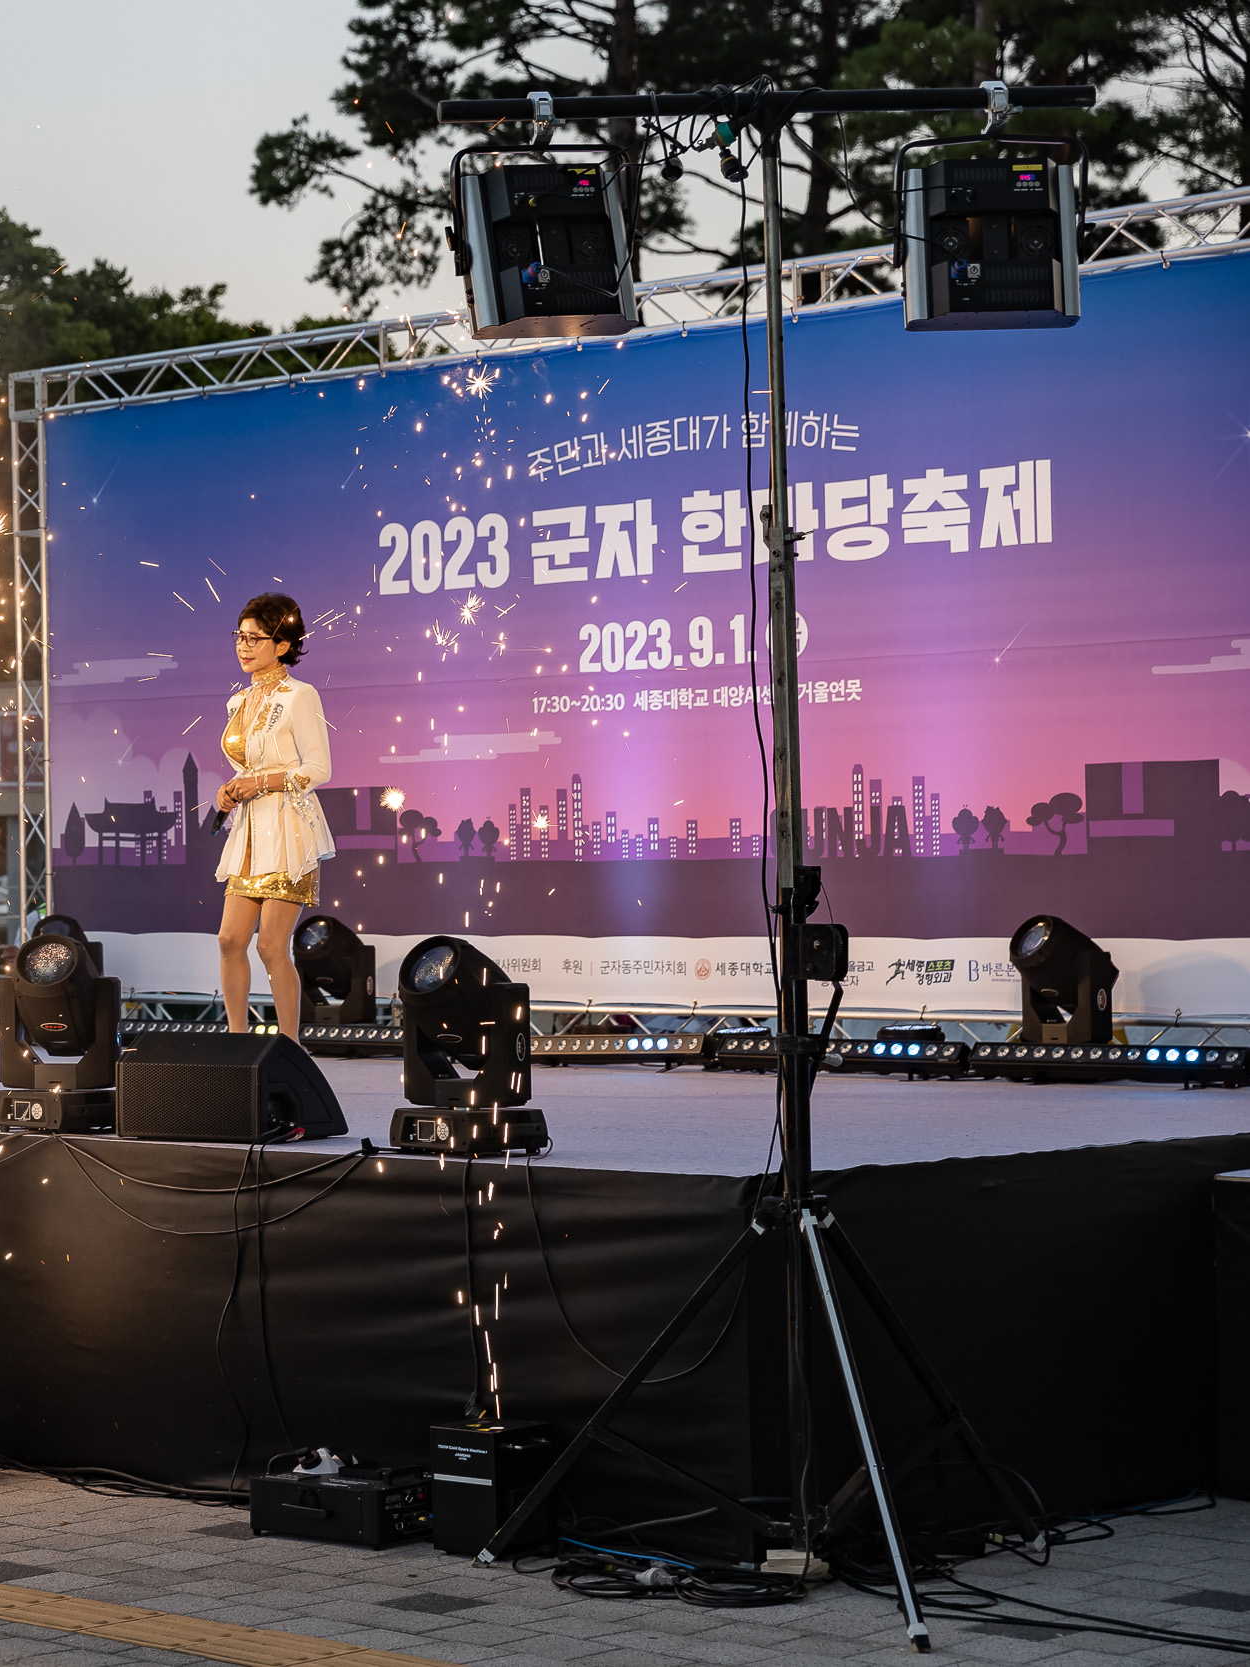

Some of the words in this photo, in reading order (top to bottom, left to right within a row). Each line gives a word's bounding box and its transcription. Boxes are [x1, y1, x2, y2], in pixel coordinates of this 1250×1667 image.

[528, 432, 608, 482] 주민과
[618, 414, 731, 461] 세종대가
[379, 513, 510, 595] 2023
[531, 499, 658, 585] 군자
[532, 693, 625, 714] 17:30~20:30
[633, 688, 709, 711] 세종대학교
[712, 685, 775, 708] 대양AI센
[495, 957, 542, 974] 사위원회
[561, 959, 583, 975] 후원
[599, 959, 687, 976] 군자동주민자치회
[715, 961, 774, 977] 세종대학교
[905, 959, 925, 972] 세종
[927, 960, 953, 972] 스포츠
[982, 962, 1017, 978] 바른본
[915, 972, 953, 986] 정형외과
